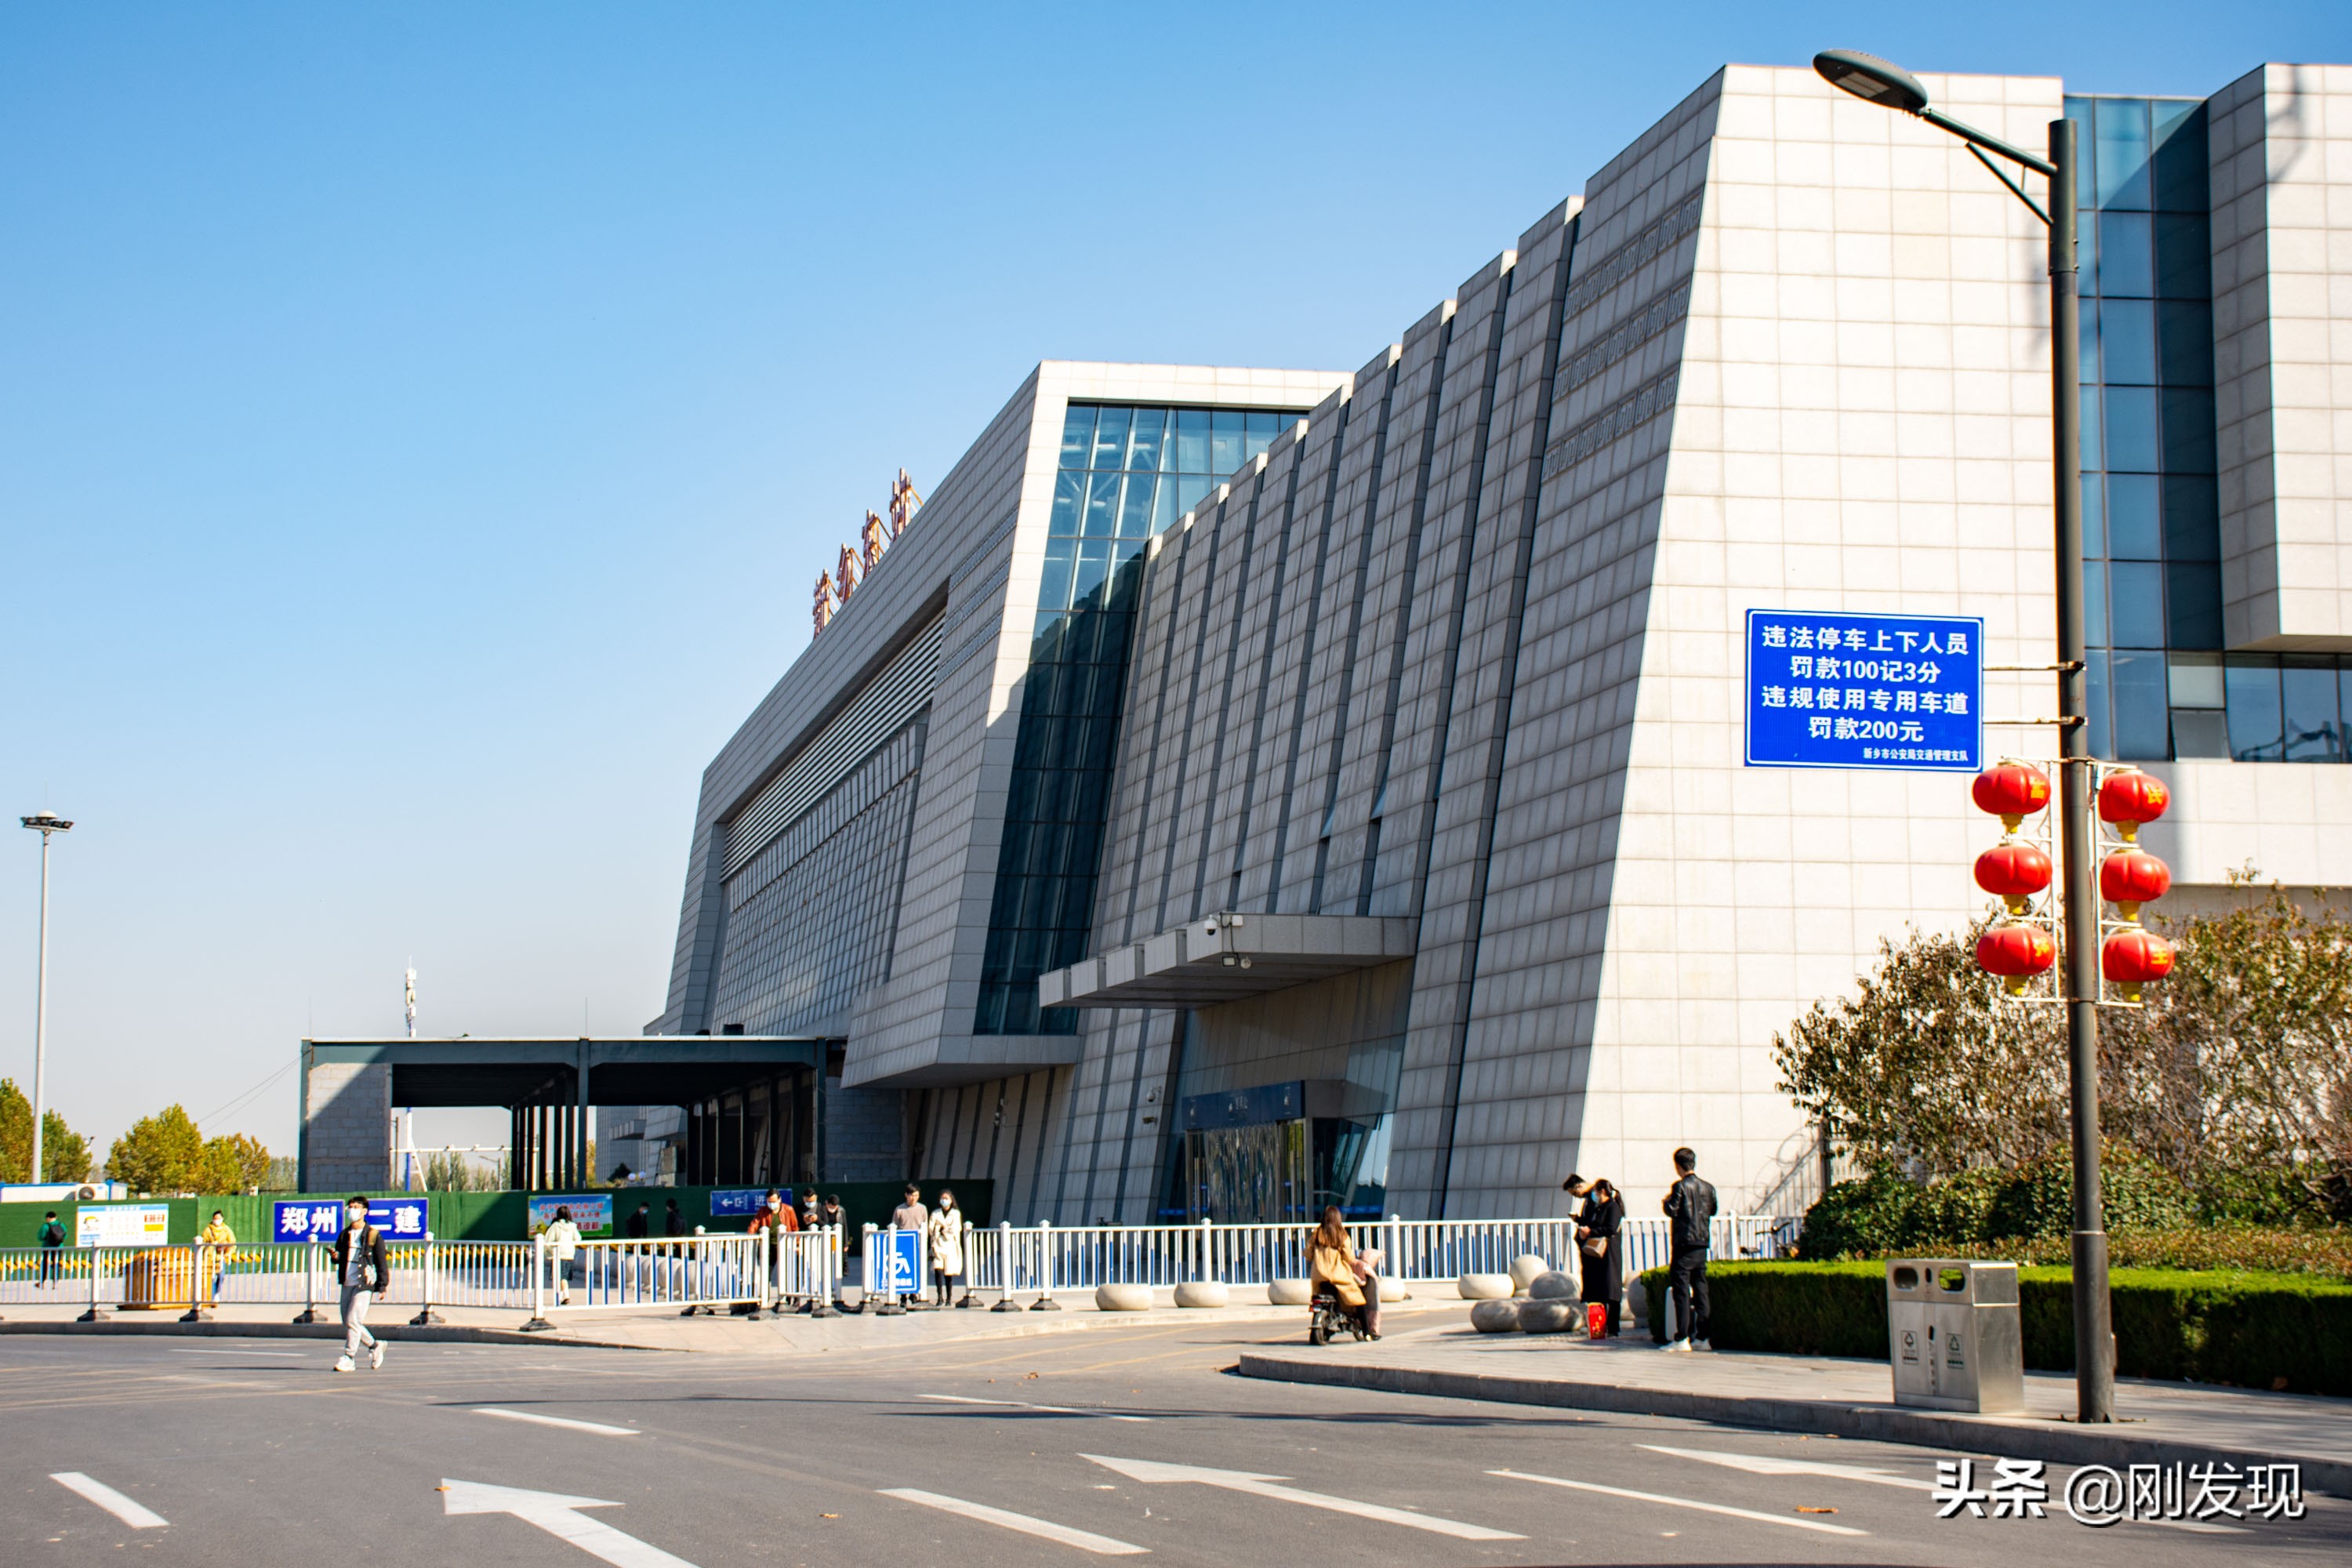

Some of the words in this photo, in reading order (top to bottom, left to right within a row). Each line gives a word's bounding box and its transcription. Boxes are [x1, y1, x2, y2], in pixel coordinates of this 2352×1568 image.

[1762, 626, 1969, 655] 违法停车上下人员
[1790, 655, 1941, 683] 罚款100记3分
[1762, 685, 1969, 714] 违规使用专用车道
[1808, 717, 1924, 742] 罚款200元
[1863, 747, 1969, 762] 新乡市公安局交通管理支队
